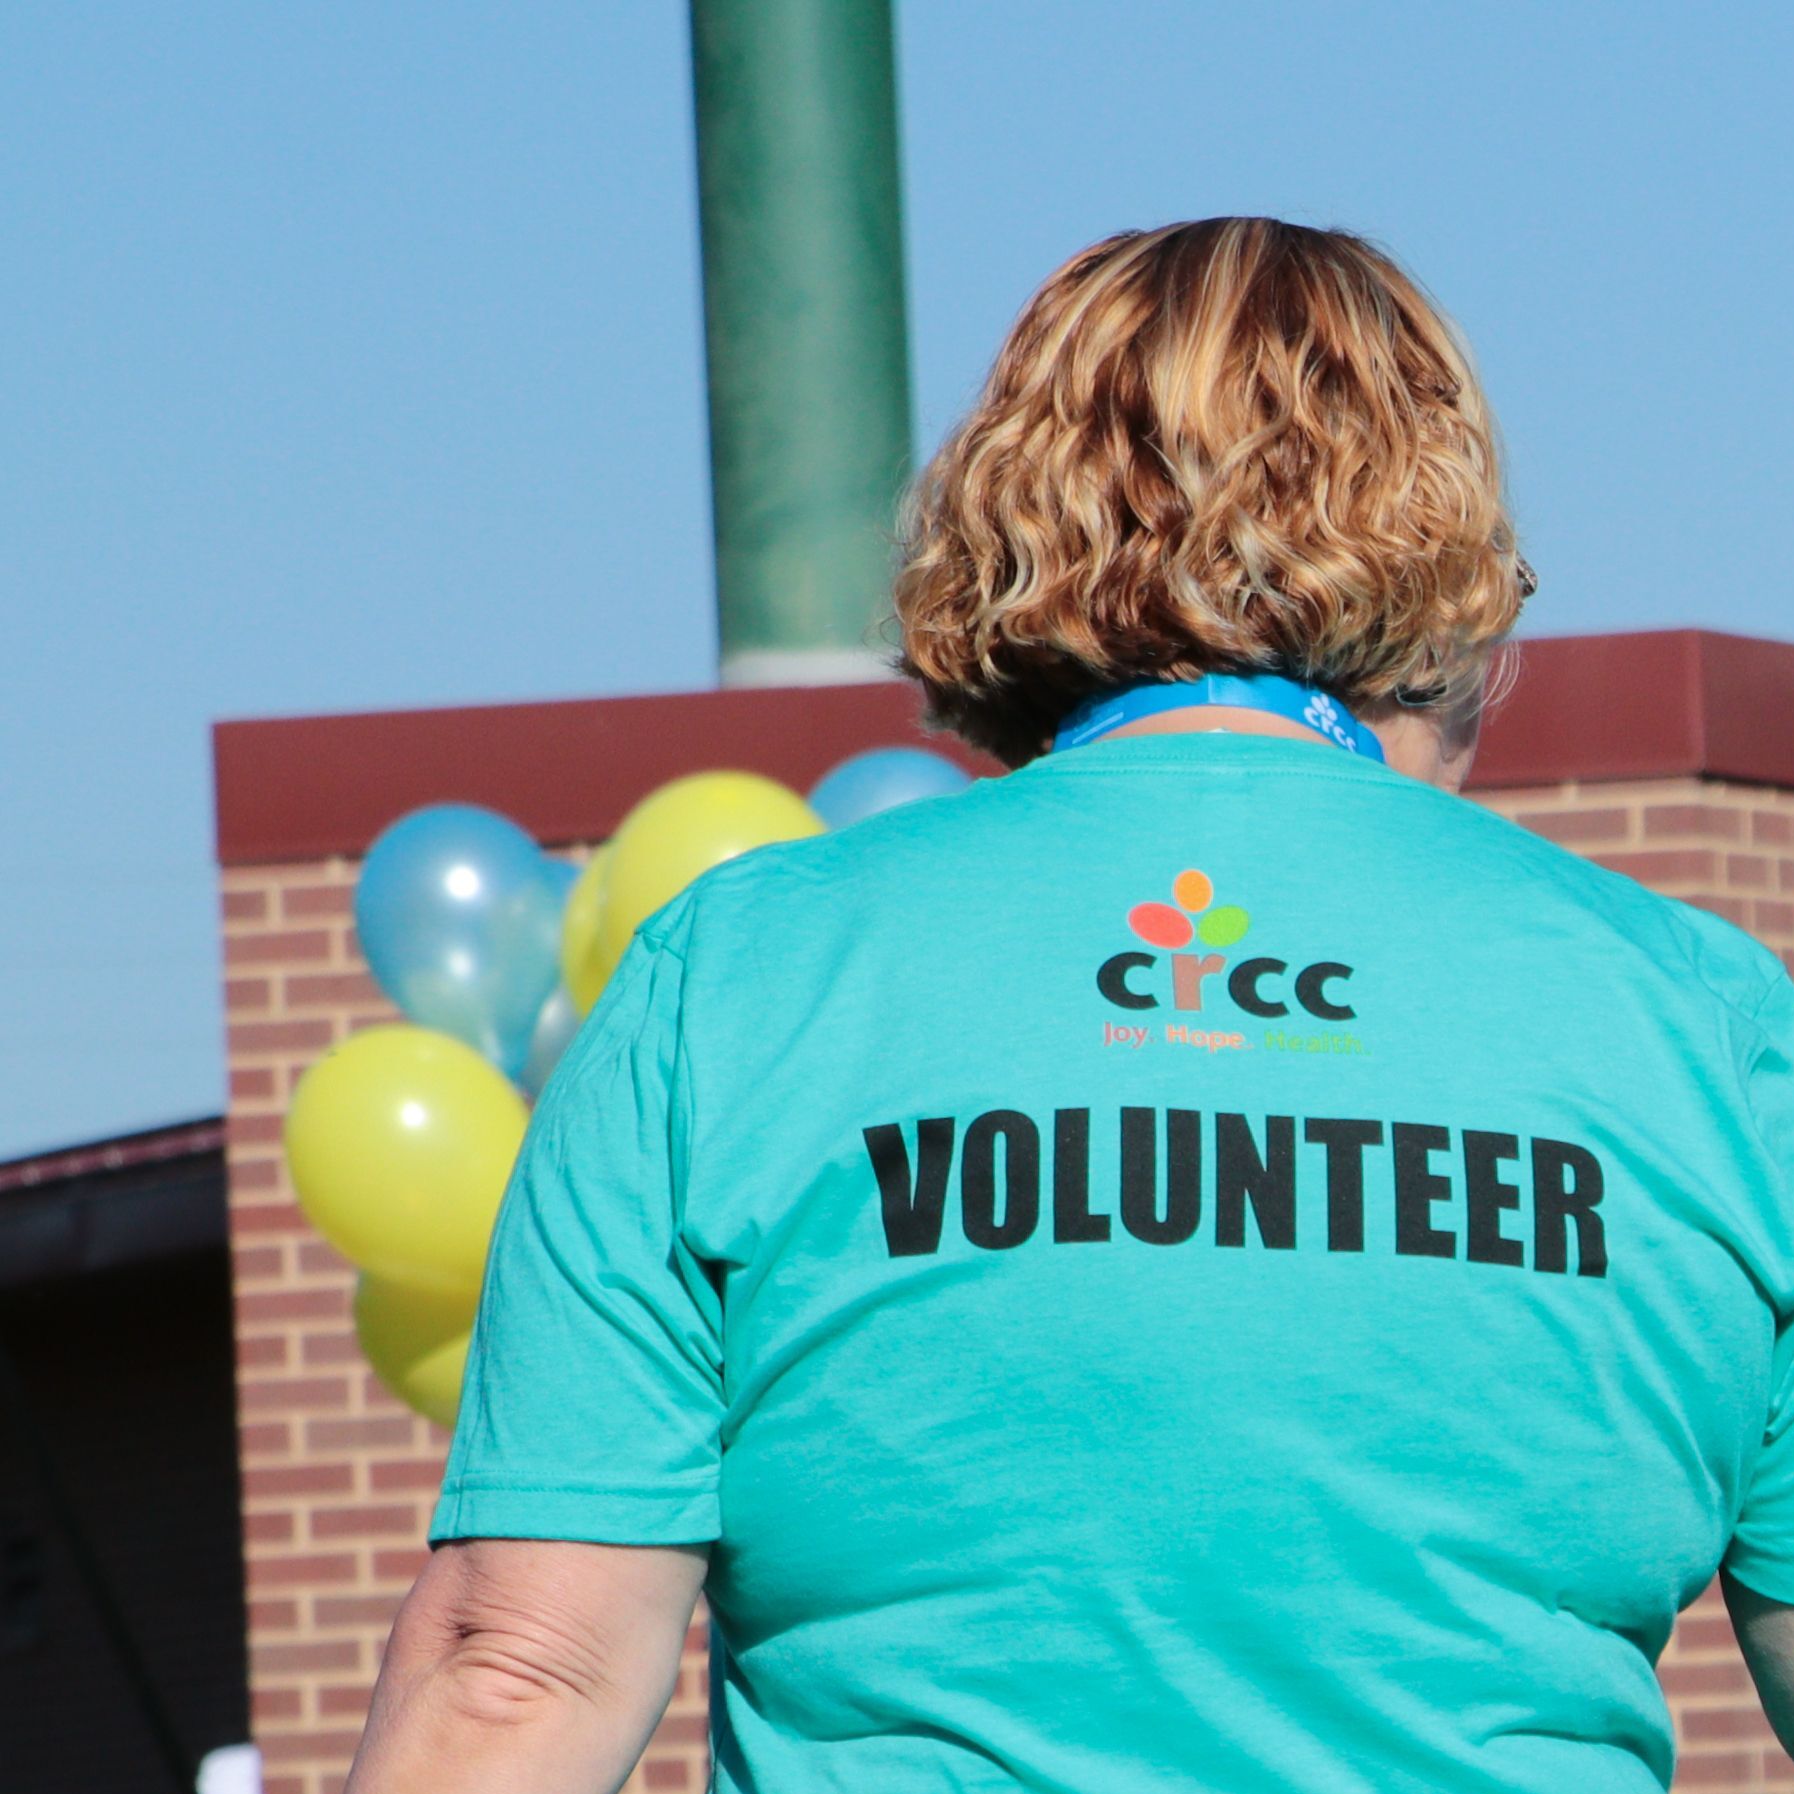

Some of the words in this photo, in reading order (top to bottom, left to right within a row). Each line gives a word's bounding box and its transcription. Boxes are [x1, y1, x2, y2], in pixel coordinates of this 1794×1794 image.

[1096, 951, 1358, 1021] crcc
[1104, 1021, 1154, 1049] Joy.
[1166, 1024, 1254, 1053] Hope.
[1264, 1030, 1373, 1056] Health.
[862, 1106, 1610, 1279] VOLUNTEER
